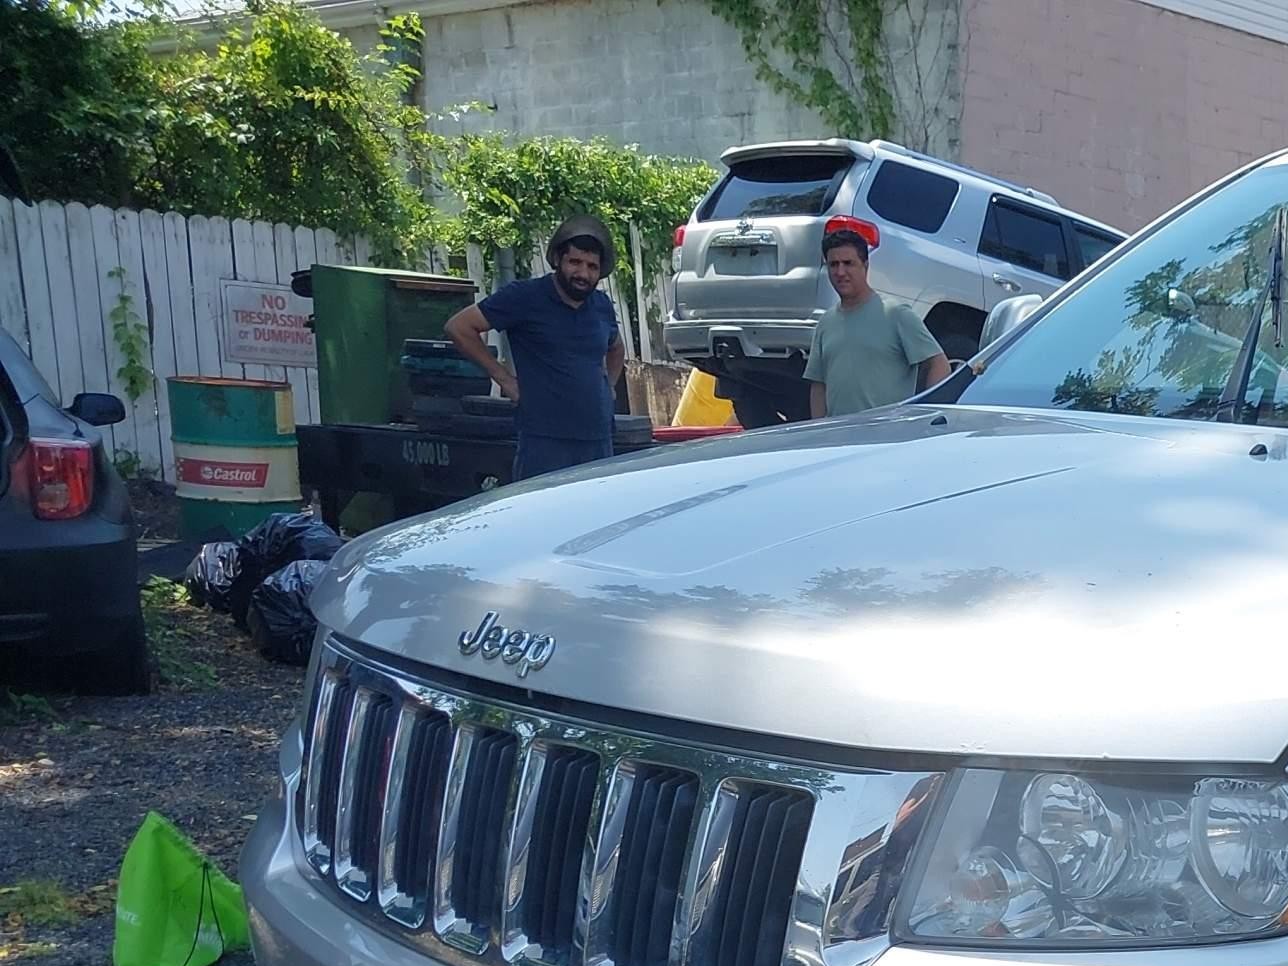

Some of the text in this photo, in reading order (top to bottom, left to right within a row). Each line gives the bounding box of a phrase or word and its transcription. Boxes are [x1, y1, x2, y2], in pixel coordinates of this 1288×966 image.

[261, 294, 286, 311] NO
[233, 309, 308, 329] TRESPASSIN
[239, 327, 313, 346] or DUMPING
[213, 467, 257, 481] Castrol
[458, 610, 556, 679] Jeep
